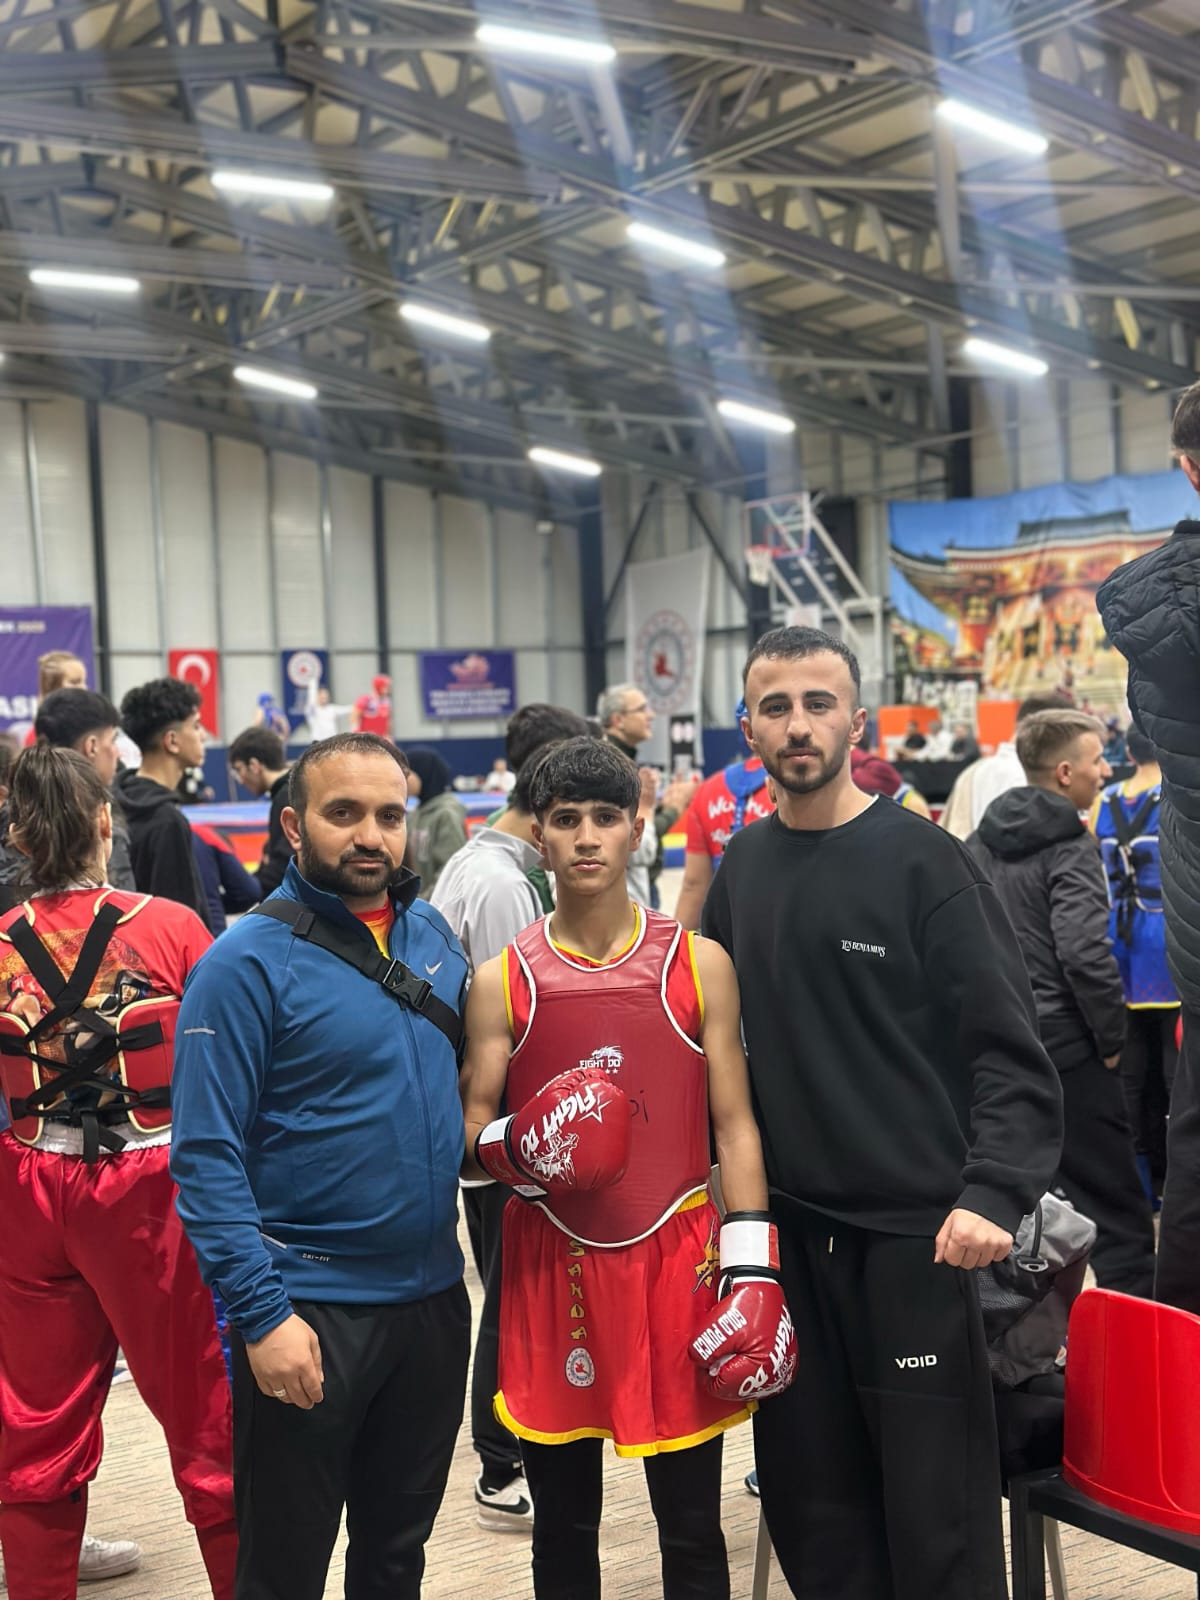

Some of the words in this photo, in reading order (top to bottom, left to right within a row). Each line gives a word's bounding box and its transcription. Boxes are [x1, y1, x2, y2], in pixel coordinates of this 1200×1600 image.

[708, 796, 770, 820] Wuhu
[852, 941, 886, 958] BENJAMINS
[579, 1059, 604, 1069] FIGHT
[607, 1059, 621, 1068] DO
[542, 1085, 597, 1140] FIGHT
[520, 1124, 540, 1162] DO
[718, 1307, 748, 1336] GOLD
[692, 1323, 727, 1361] PUNCH
[895, 1354, 938, 1369] VOID
[738, 1364, 769, 1396] DO
